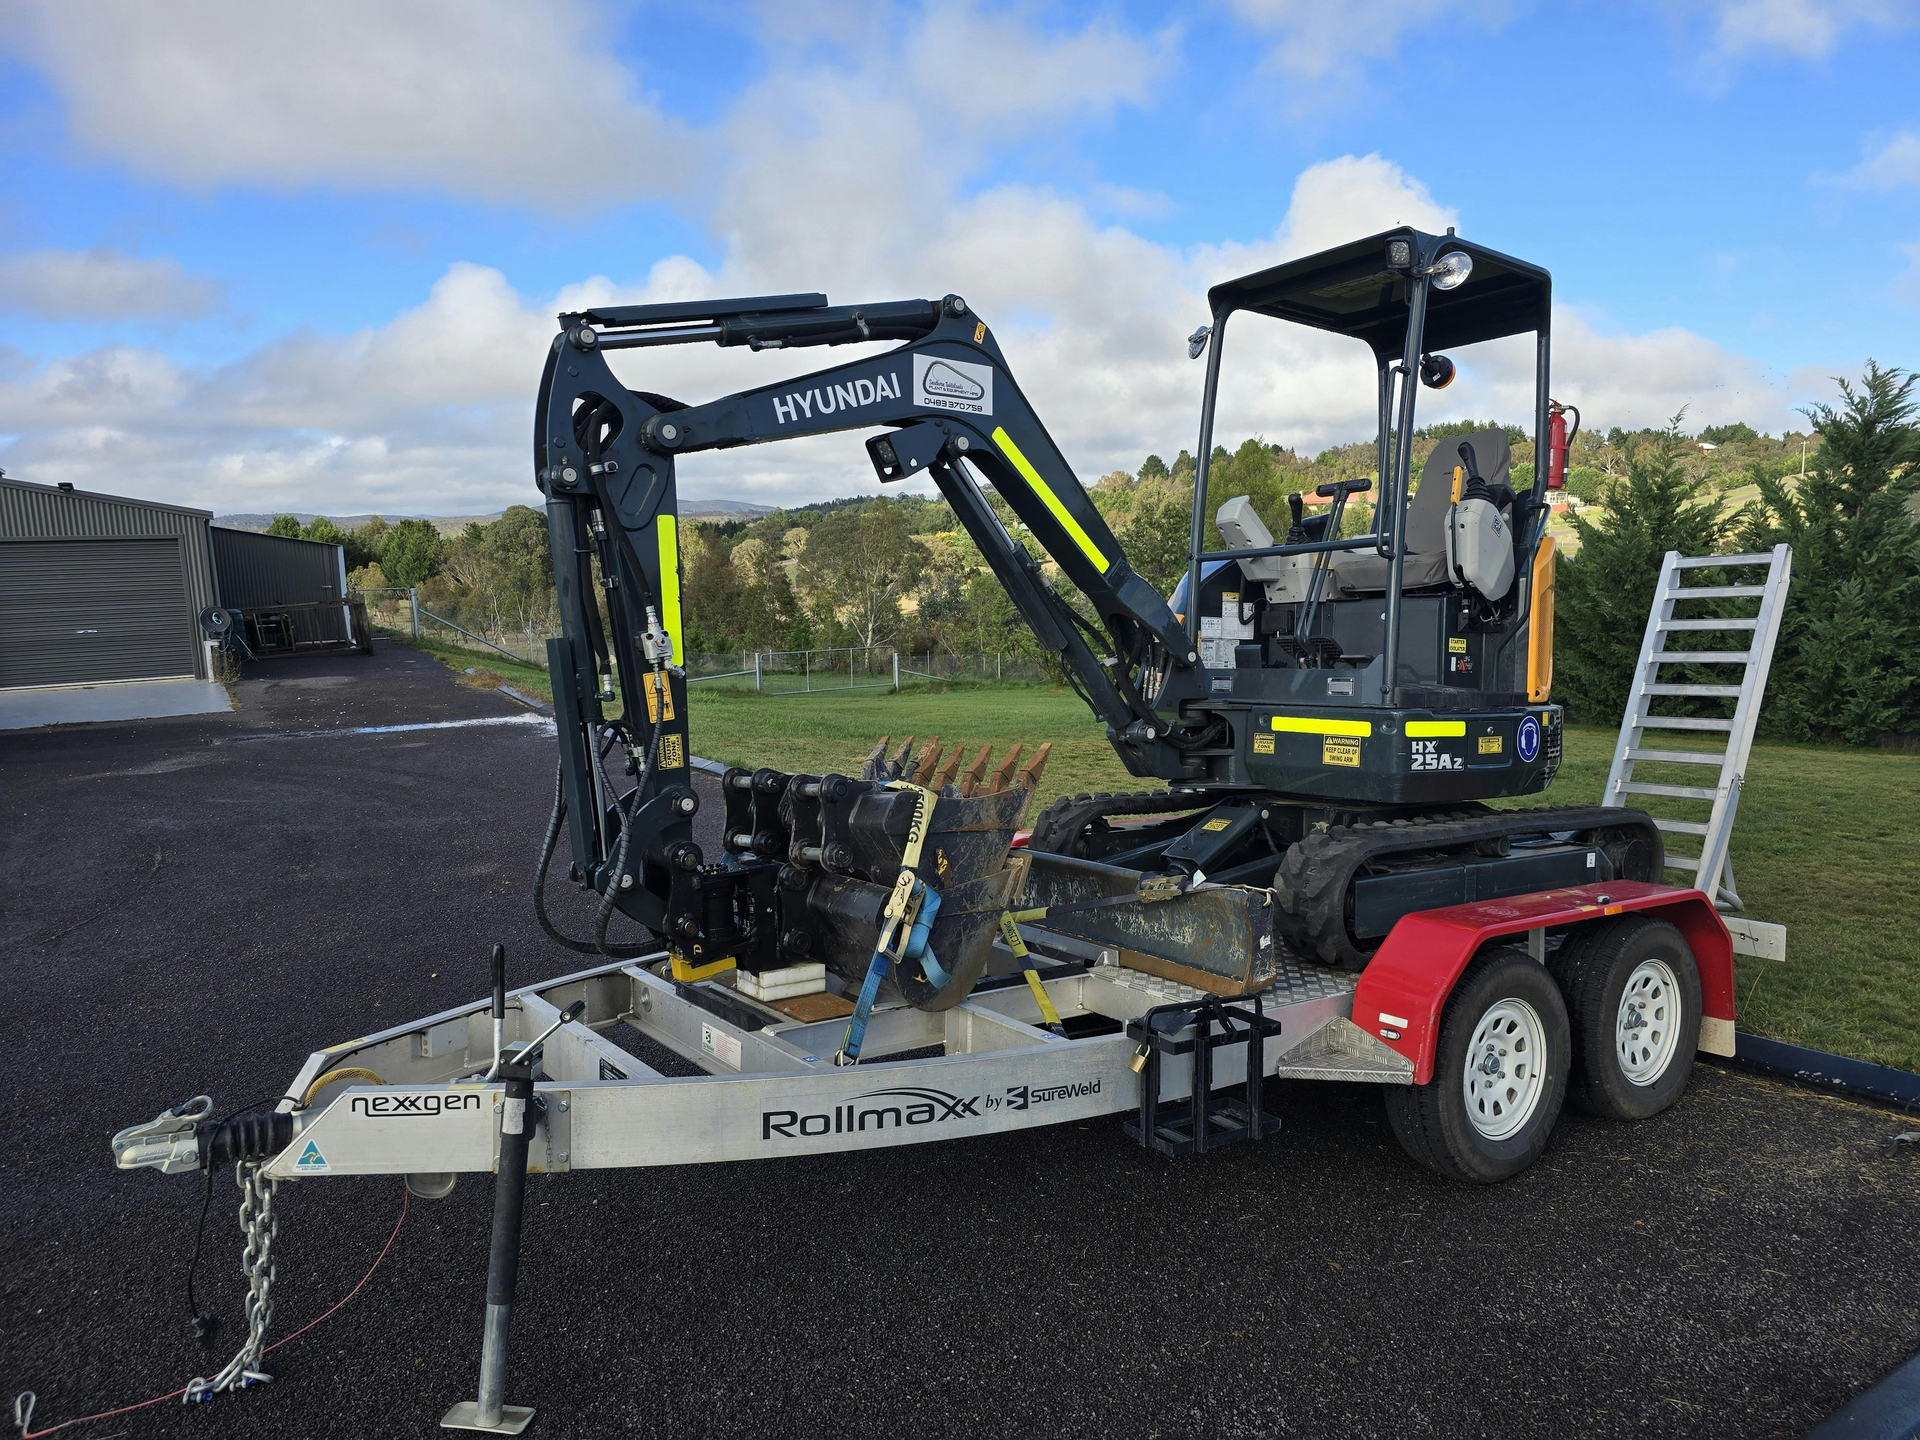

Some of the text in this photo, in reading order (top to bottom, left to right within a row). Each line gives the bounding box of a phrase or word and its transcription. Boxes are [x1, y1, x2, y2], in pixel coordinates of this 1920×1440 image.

[772, 372, 902, 424] HYUNDAI
[1331, 737, 1359, 746] WARNING
[1411, 741, 1437, 753] HX
[762, 1079, 1101, 1140] Rollmaxx by SureWeld
